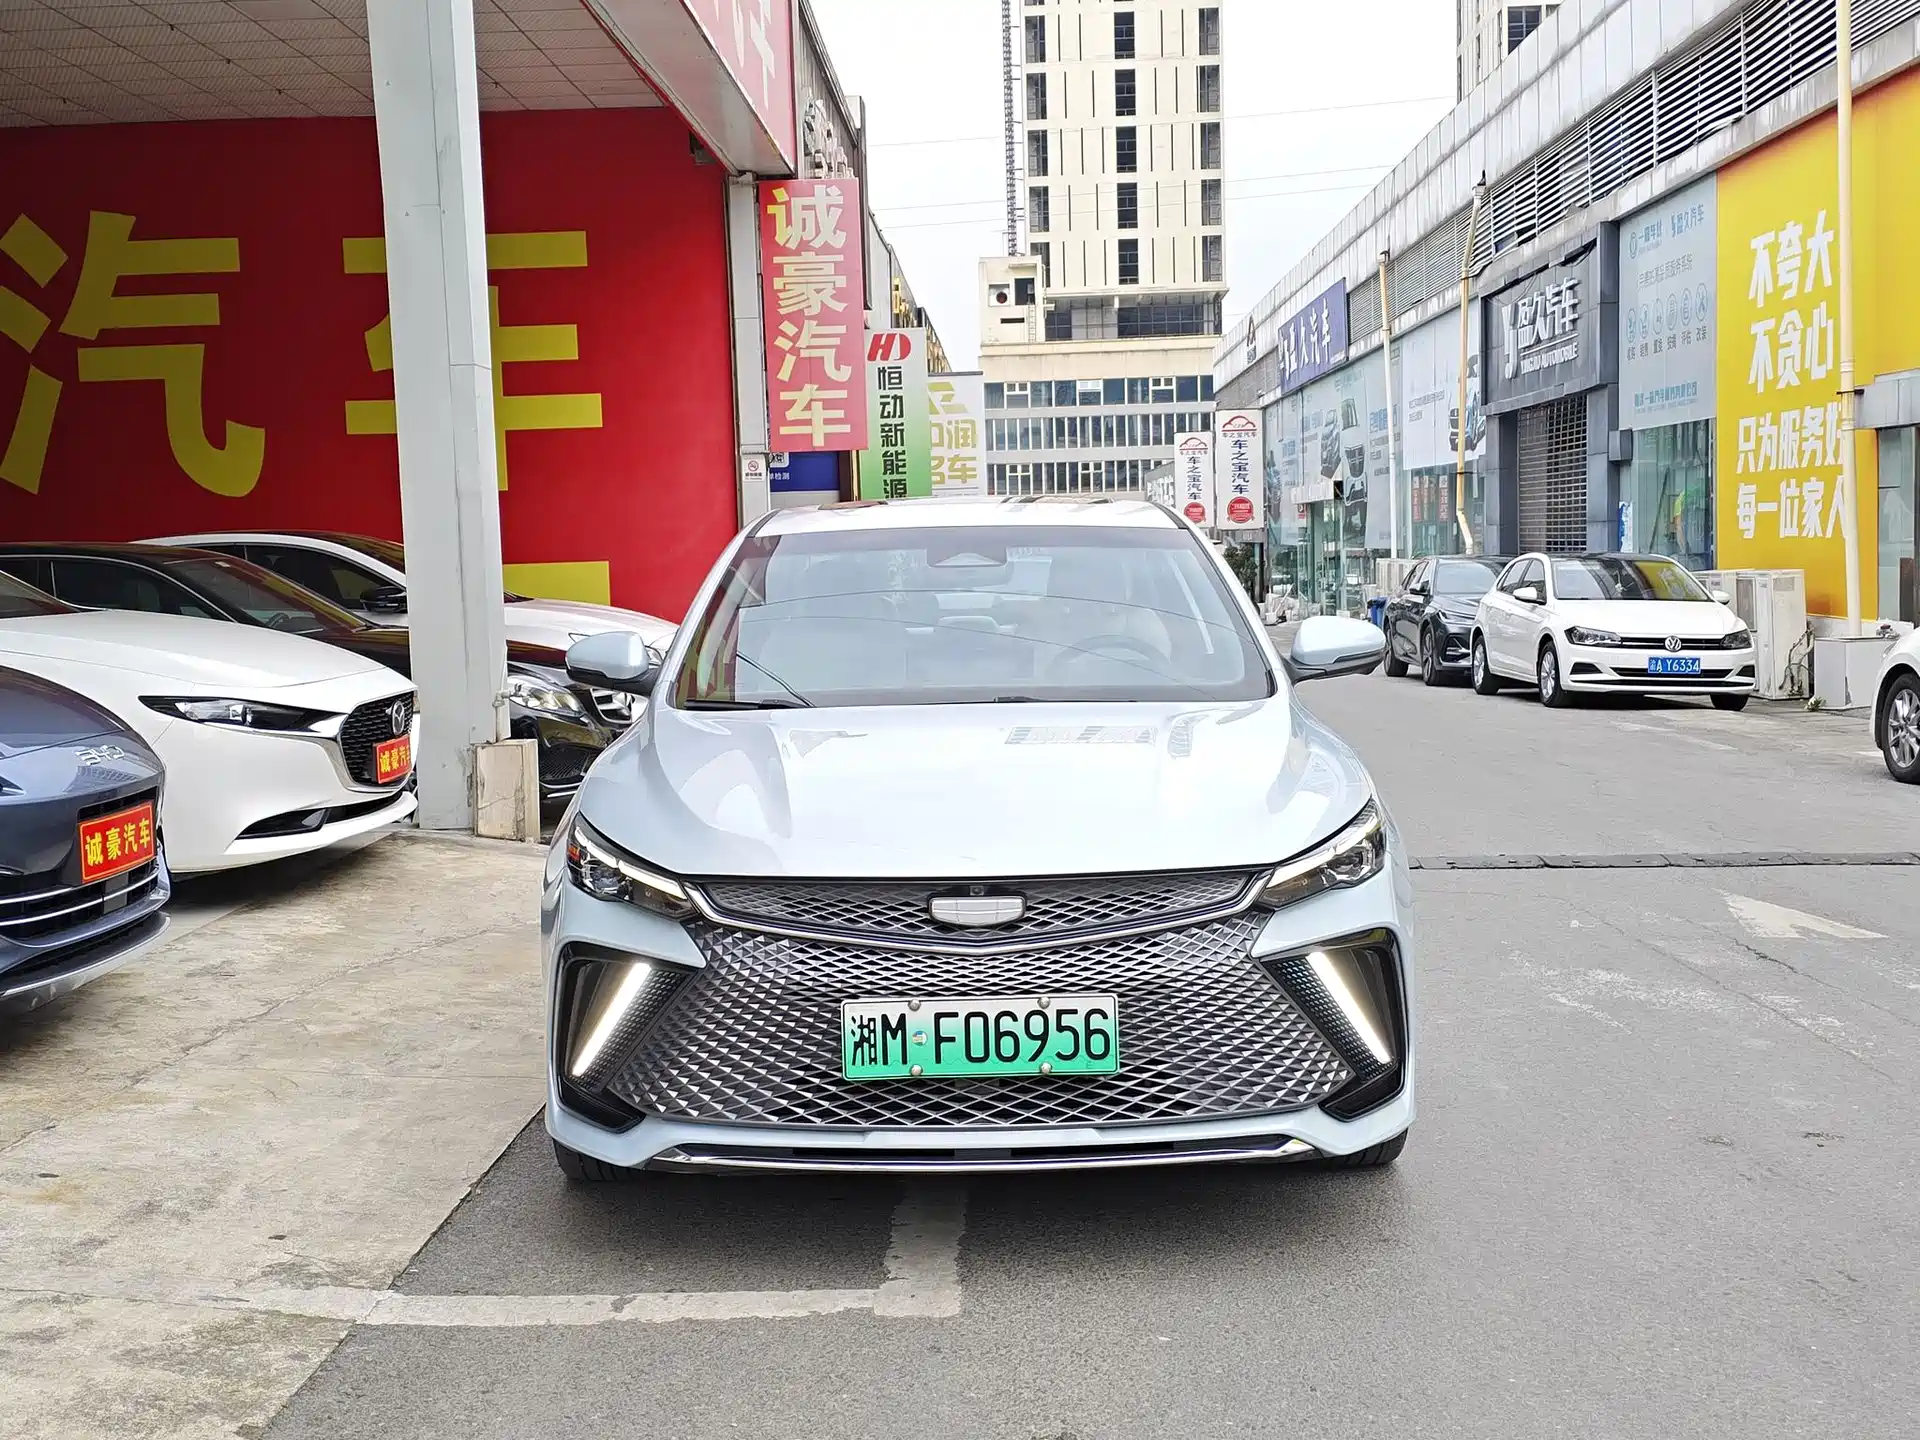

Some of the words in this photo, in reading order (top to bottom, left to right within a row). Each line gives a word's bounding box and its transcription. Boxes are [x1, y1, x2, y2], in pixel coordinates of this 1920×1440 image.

[1748, 209, 1835, 308] 不夸大
[767, 184, 852, 447] 诚豪汽车
[1748, 300, 1835, 394] 不贪心
[0, 211, 603, 497] 汽车
[877, 365, 908, 499] 恒动新能源
[1736, 401, 1844, 474] 只为服务好
[1186, 456, 1202, 500] 车之宝汽车
[1231, 439, 1250, 494] 车之宝汽车
[1736, 474, 1846, 539] 每一位家人
[1666, 659, 1699, 672] Y6334
[380, 744, 410, 773] 诚豪汽
[85, 817, 151, 867] 诚豪汽车
[851, 1013, 908, 1066] 湘M
[934, 1008, 1111, 1064] F06956
